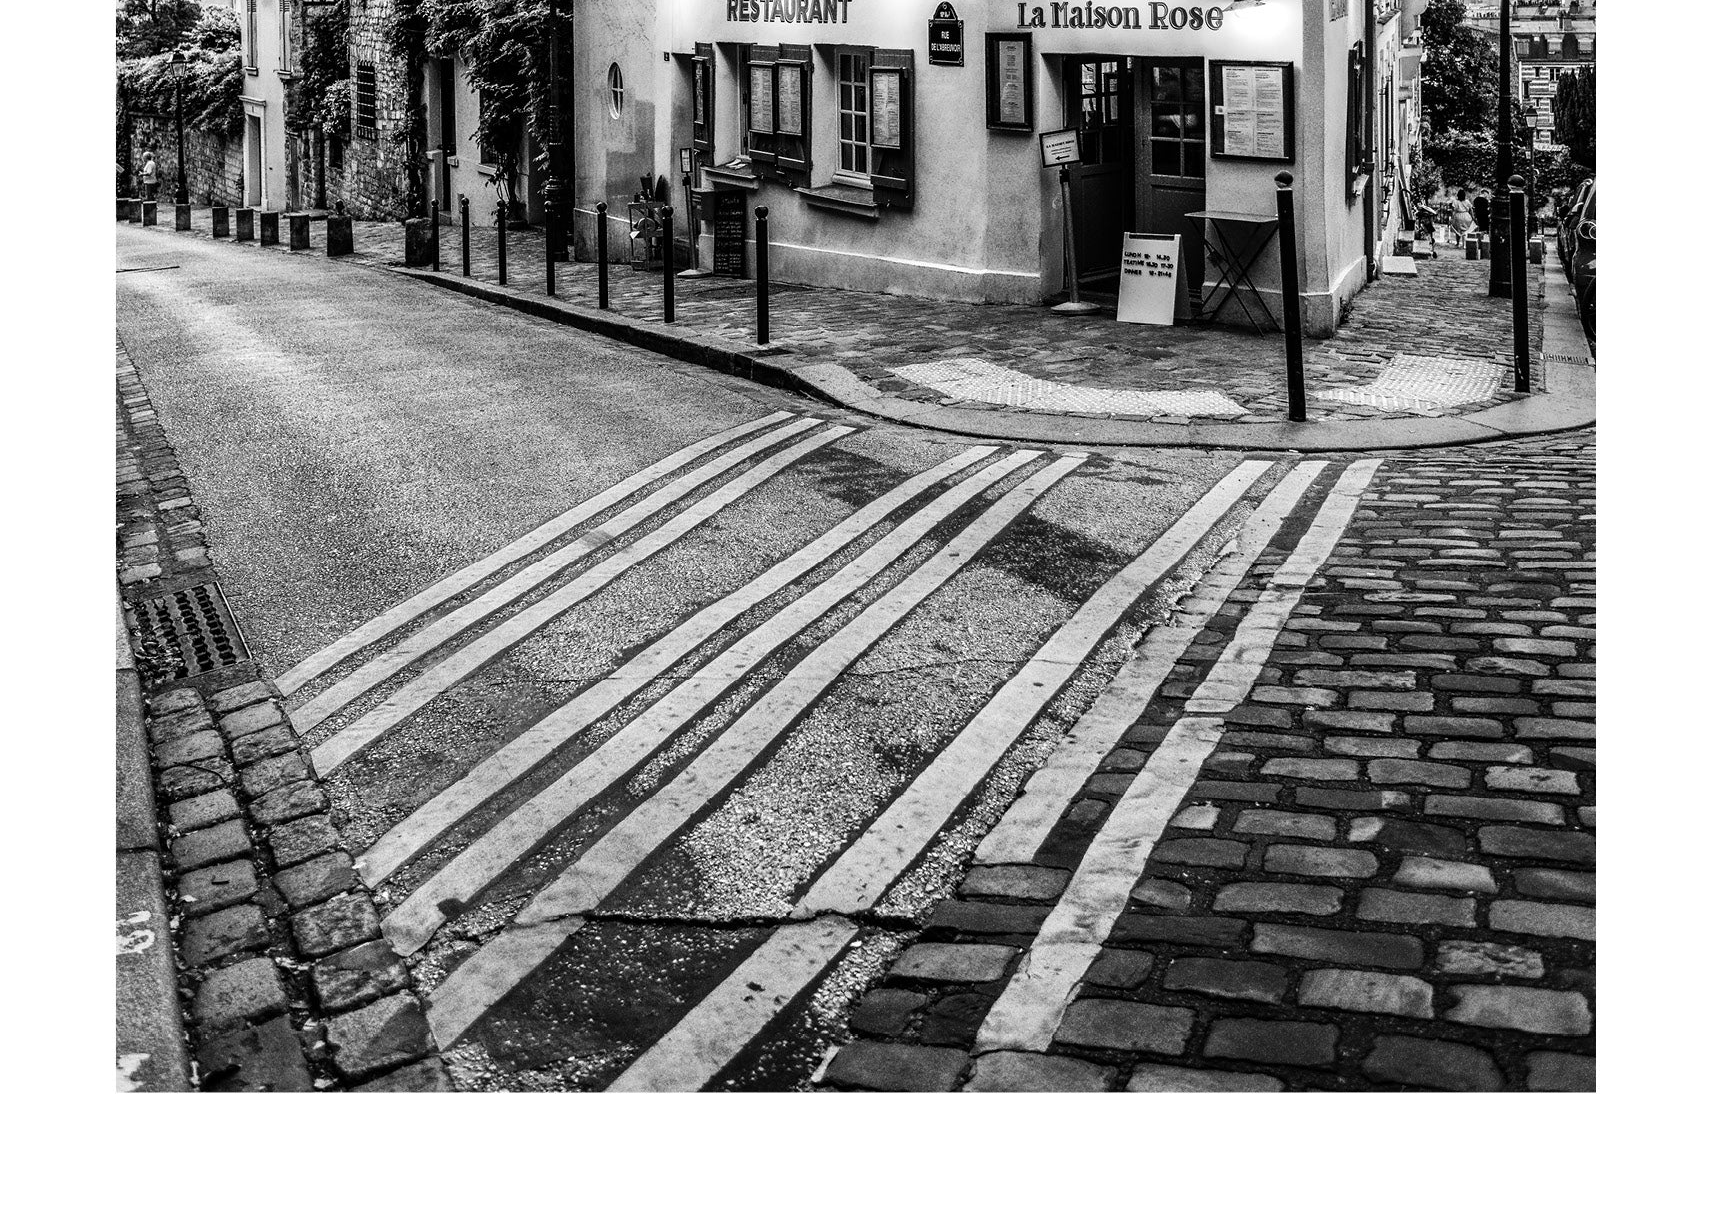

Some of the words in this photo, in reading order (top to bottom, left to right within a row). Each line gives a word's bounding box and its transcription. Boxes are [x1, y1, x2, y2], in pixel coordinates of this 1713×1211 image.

[1017, 2, 1047, 29] La
[1050, 0, 1142, 30] Maison
[1148, 1, 1224, 31] Rose
[941, 31, 950, 40] RUE
[931, 42, 937, 51] DE
